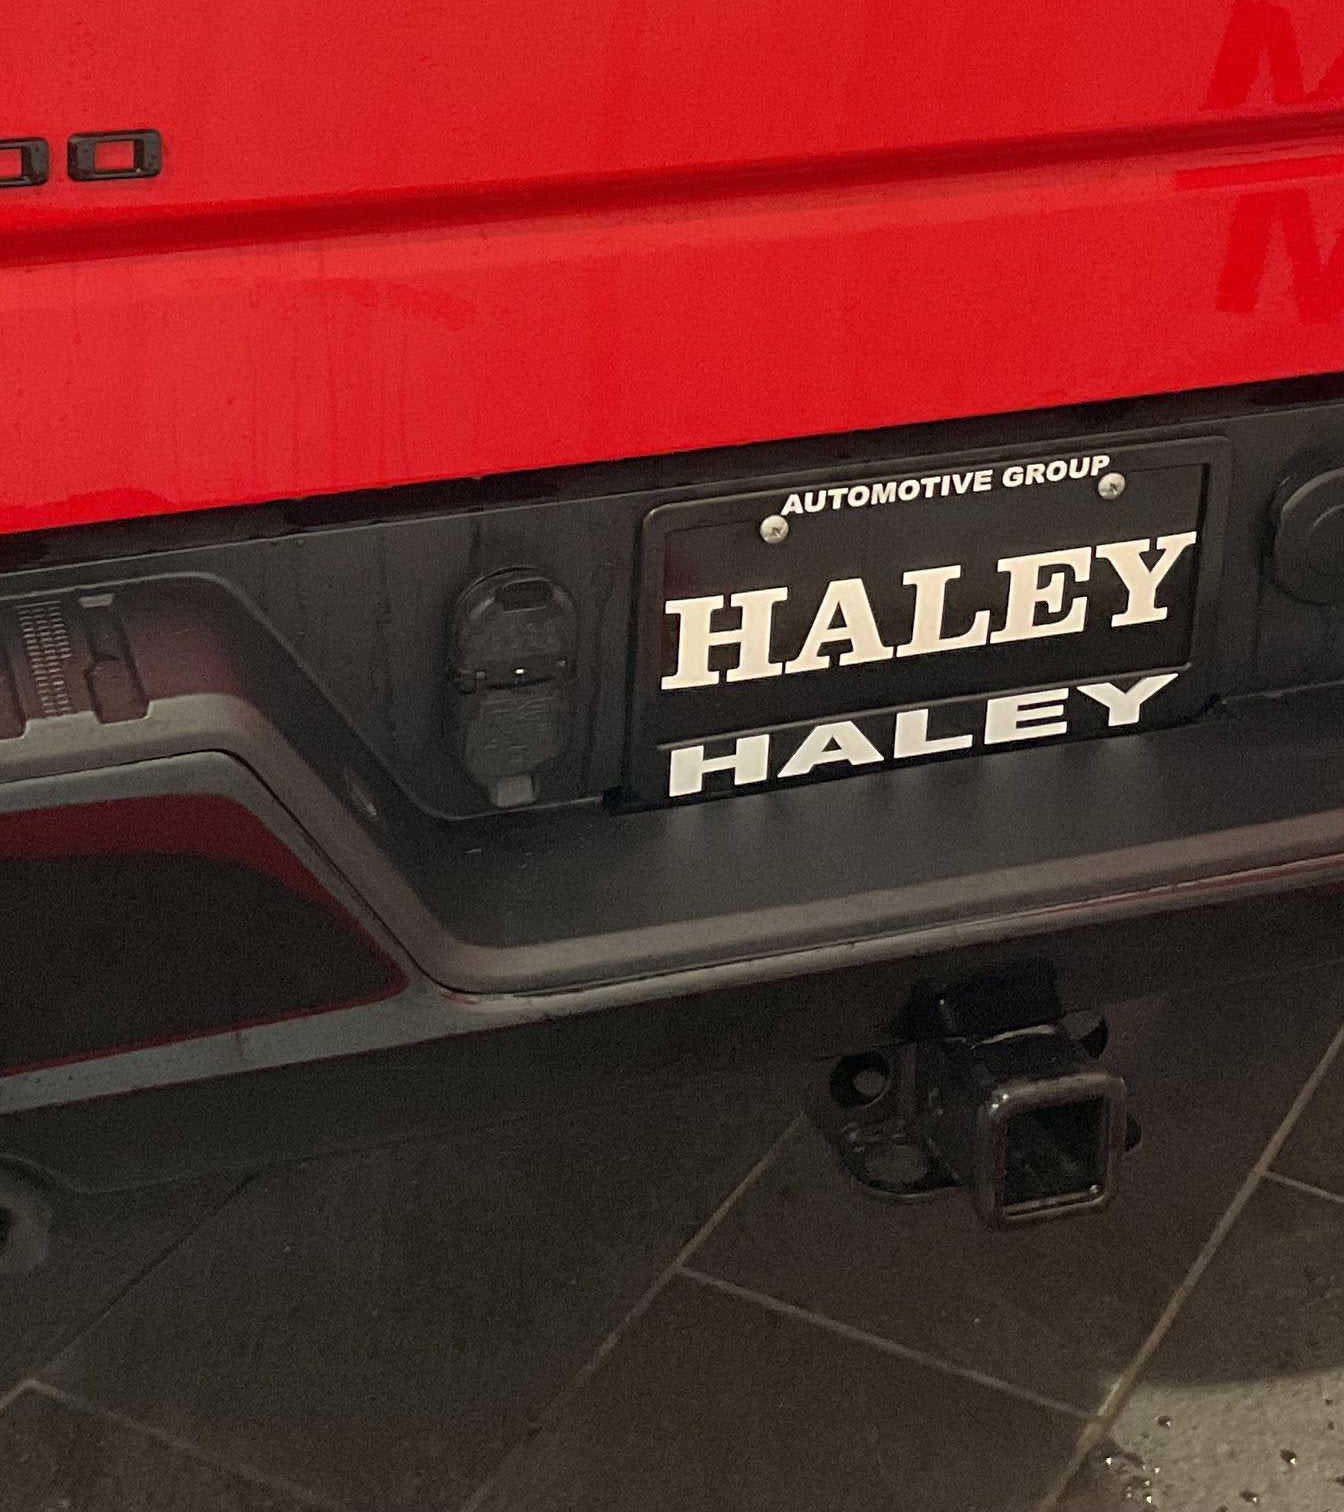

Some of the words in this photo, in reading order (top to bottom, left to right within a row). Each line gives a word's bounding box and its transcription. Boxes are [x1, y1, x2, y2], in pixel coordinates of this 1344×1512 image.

[780, 469, 993, 517] AUTOMOTIVE
[1002, 454, 1111, 488] GROUP
[661, 531, 1197, 690] HALEY
[669, 673, 1179, 797] HALEY
